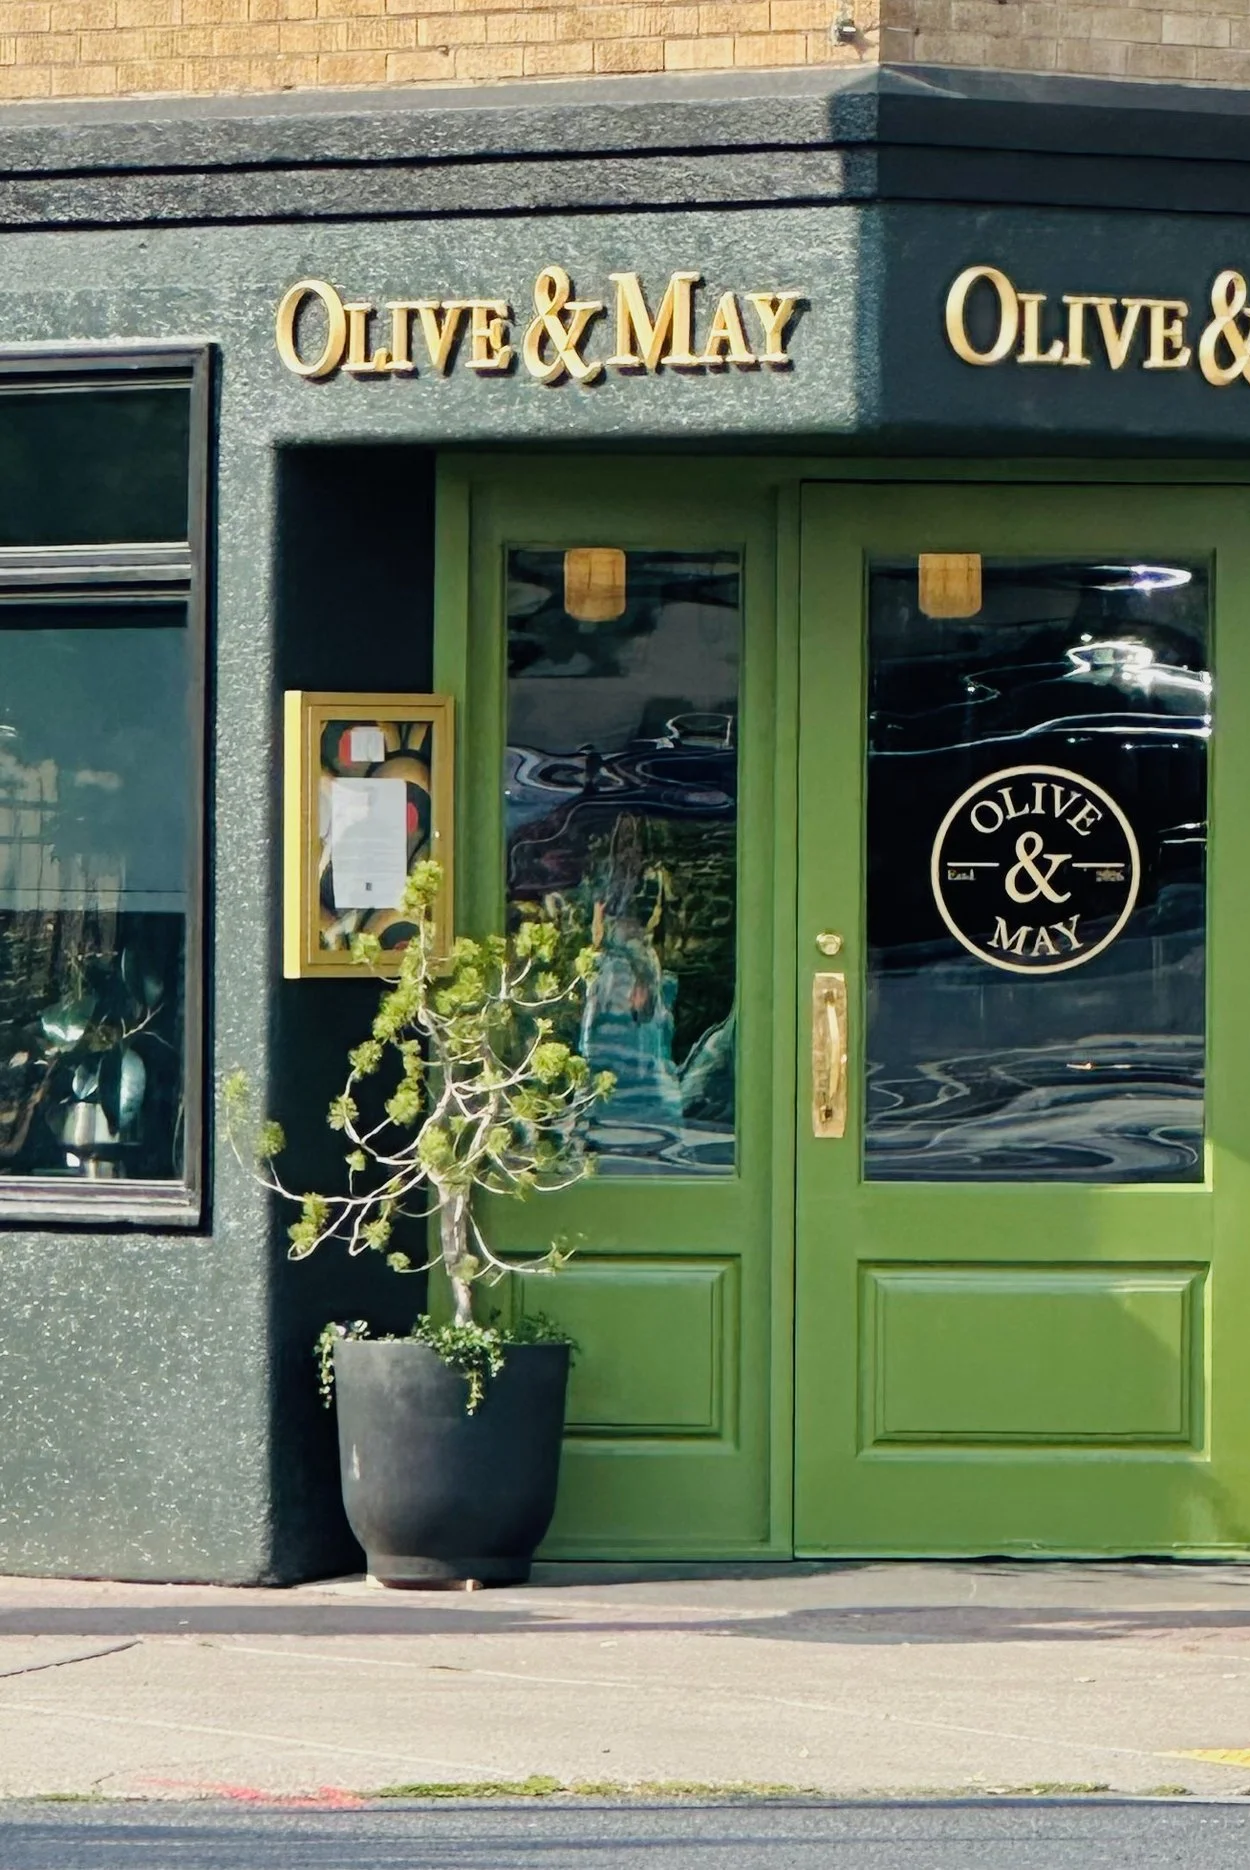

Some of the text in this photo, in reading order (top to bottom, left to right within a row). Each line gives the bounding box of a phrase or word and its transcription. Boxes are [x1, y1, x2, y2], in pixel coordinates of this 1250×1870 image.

[970, 782, 1103, 836] OLIVE
[1004, 830, 1073, 904] &
[986, 914, 1085, 957] MAY
